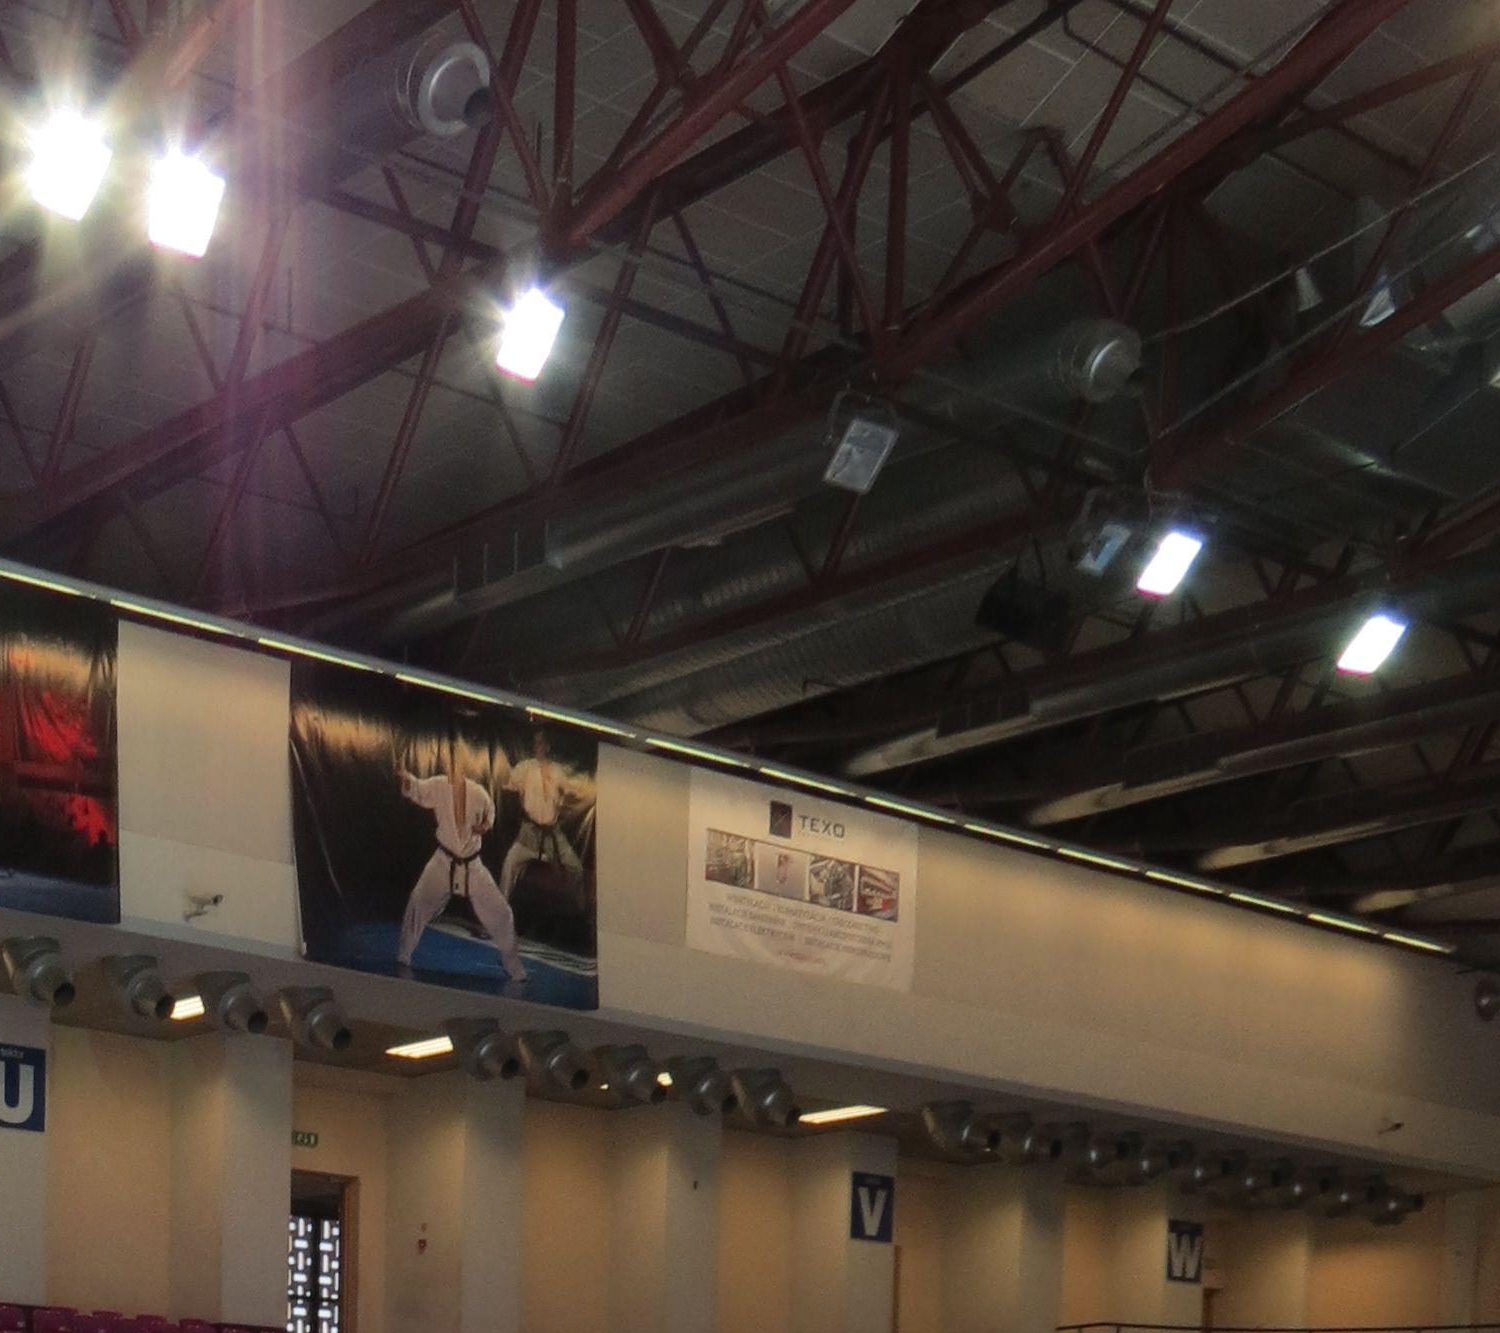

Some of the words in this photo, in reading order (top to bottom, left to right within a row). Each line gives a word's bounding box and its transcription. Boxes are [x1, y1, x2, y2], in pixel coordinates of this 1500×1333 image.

[798, 814, 846, 839] TEXO
[858, 1186, 888, 1236] V
[1167, 1232, 1204, 1279] W
